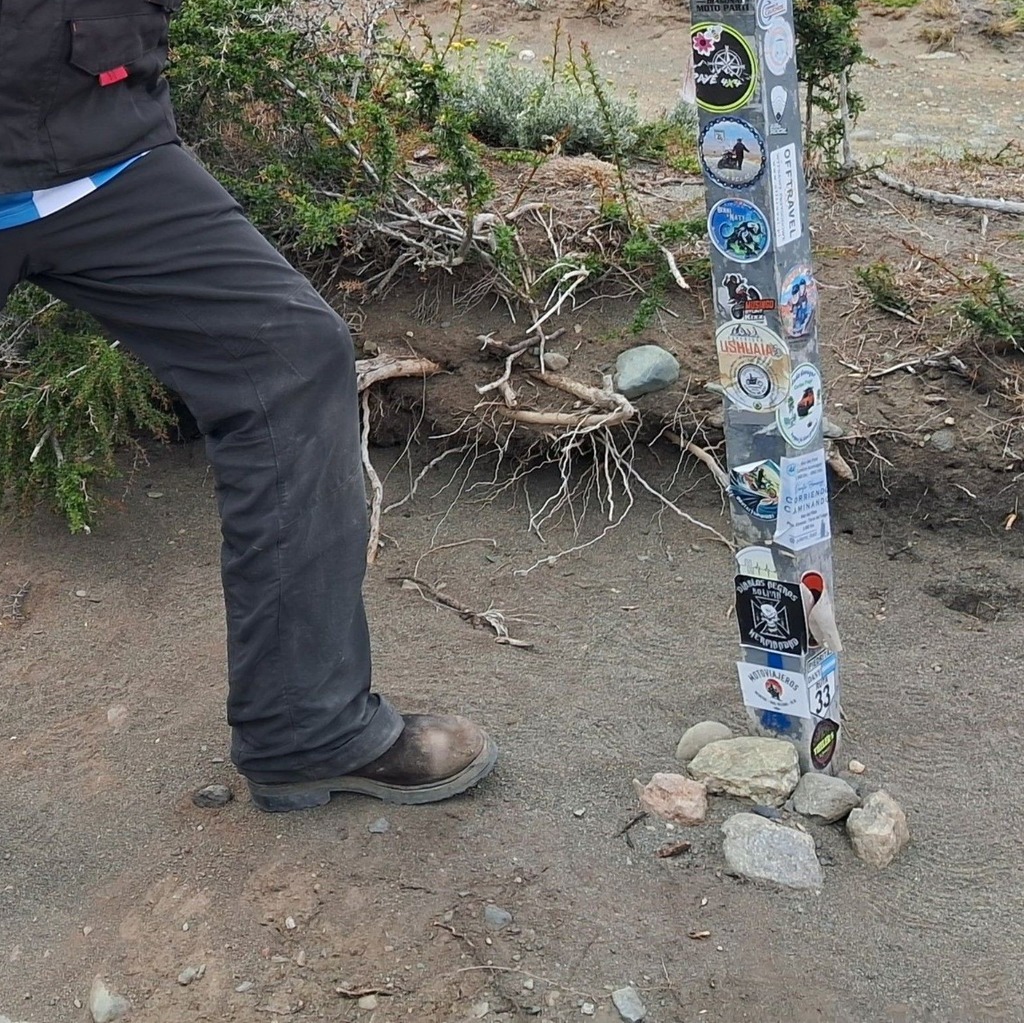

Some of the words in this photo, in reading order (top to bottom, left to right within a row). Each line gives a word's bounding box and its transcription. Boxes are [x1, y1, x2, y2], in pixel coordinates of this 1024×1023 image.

[783, 148, 797, 238] OFFTRAVEL
[719, 340, 774, 356] USHUAIA
[747, 668, 800, 692] MOTOVIAJEROS
[815, 684, 831, 714] 33
